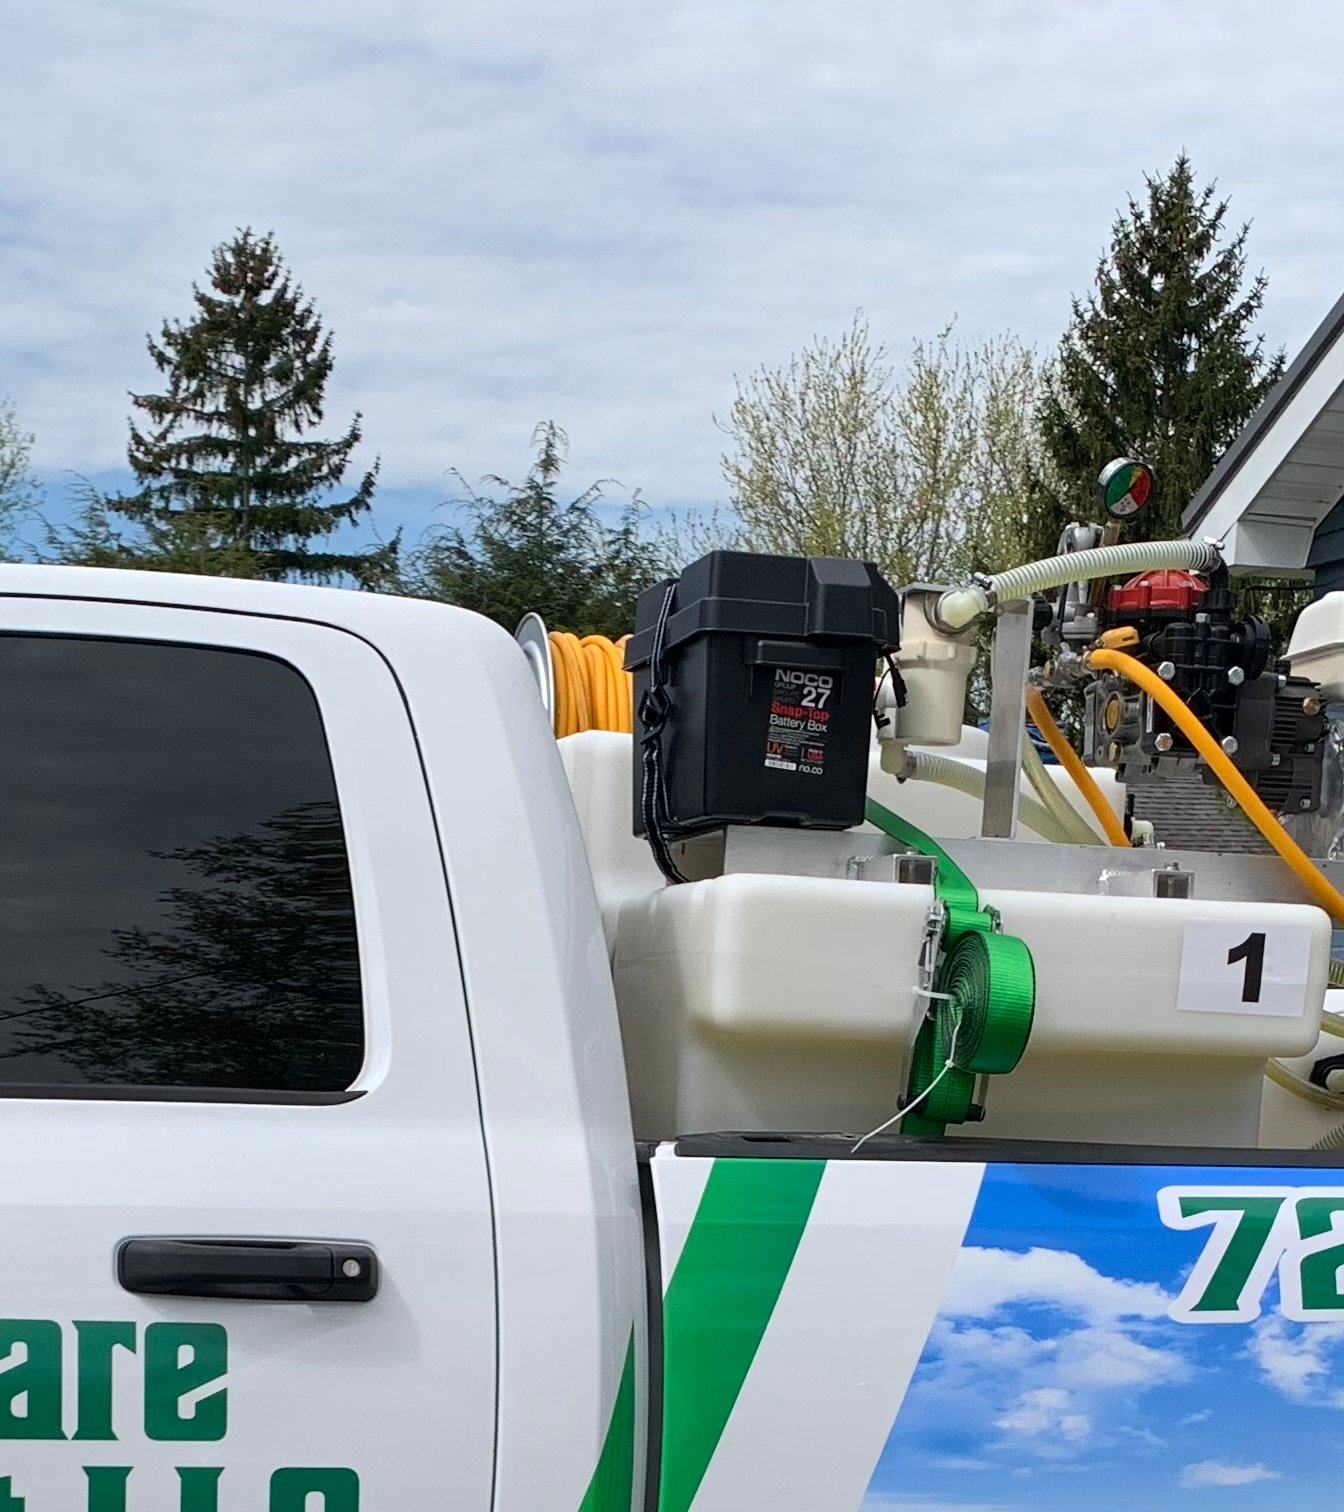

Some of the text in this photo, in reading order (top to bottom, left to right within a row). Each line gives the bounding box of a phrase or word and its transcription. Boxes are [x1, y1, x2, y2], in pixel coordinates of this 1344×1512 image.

[775, 669, 833, 689] NOCO
[801, 686, 831, 708] 27
[771, 700, 831, 722] Snap-Top
[769, 714, 828, 733] Battery Box
[766, 741, 784, 754] UV
[1227, 932, 1266, 1003] 1
